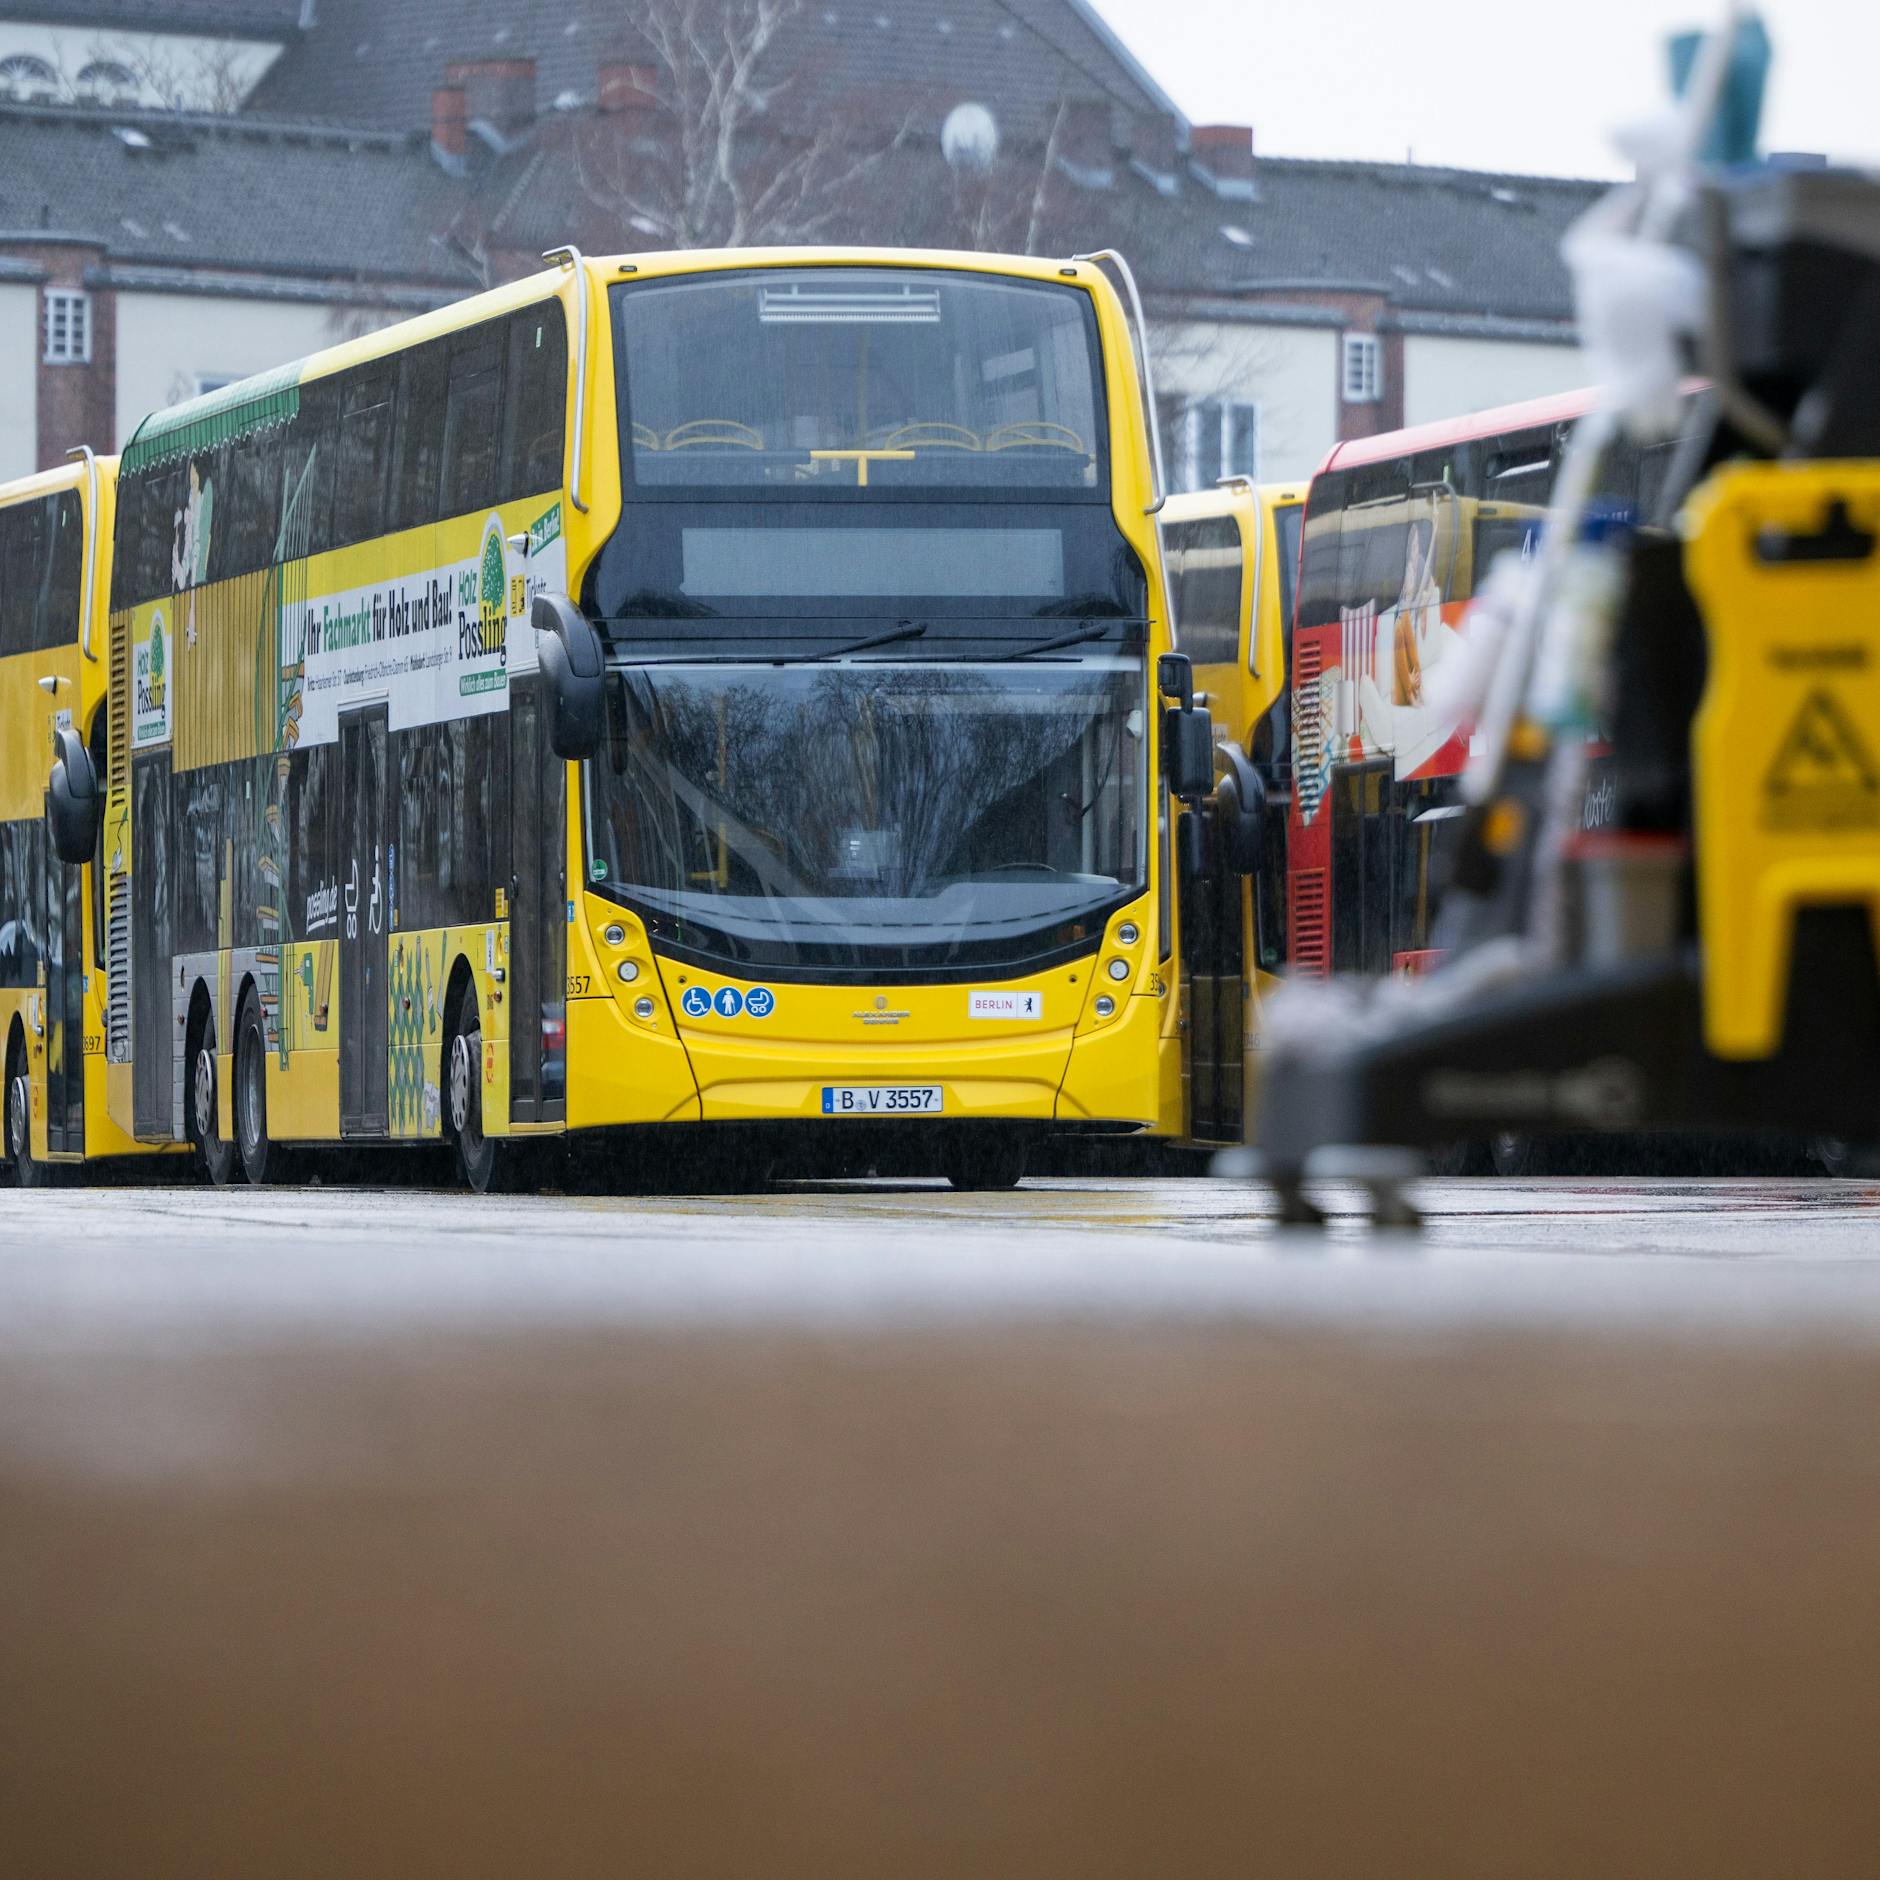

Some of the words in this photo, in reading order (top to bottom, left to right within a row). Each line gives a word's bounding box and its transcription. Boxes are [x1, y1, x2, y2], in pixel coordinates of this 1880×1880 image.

[458, 569, 477, 607] Holz
[307, 608, 321, 656] Ihr
[323, 596, 370, 652] Fachmarkt
[372, 592, 386, 642] für
[389, 587, 409, 639] Holz
[411, 580, 429, 633] und
[432, 574, 452, 628] Bau!
[458, 606, 507, 667] Possling
[137, 675, 166, 719] Possling
[975, 999, 1013, 1009] BERLIN
[841, 1090, 854, 1109] B
[868, 1090, 880, 1109] V
[886, 1089, 933, 1109] 3557
